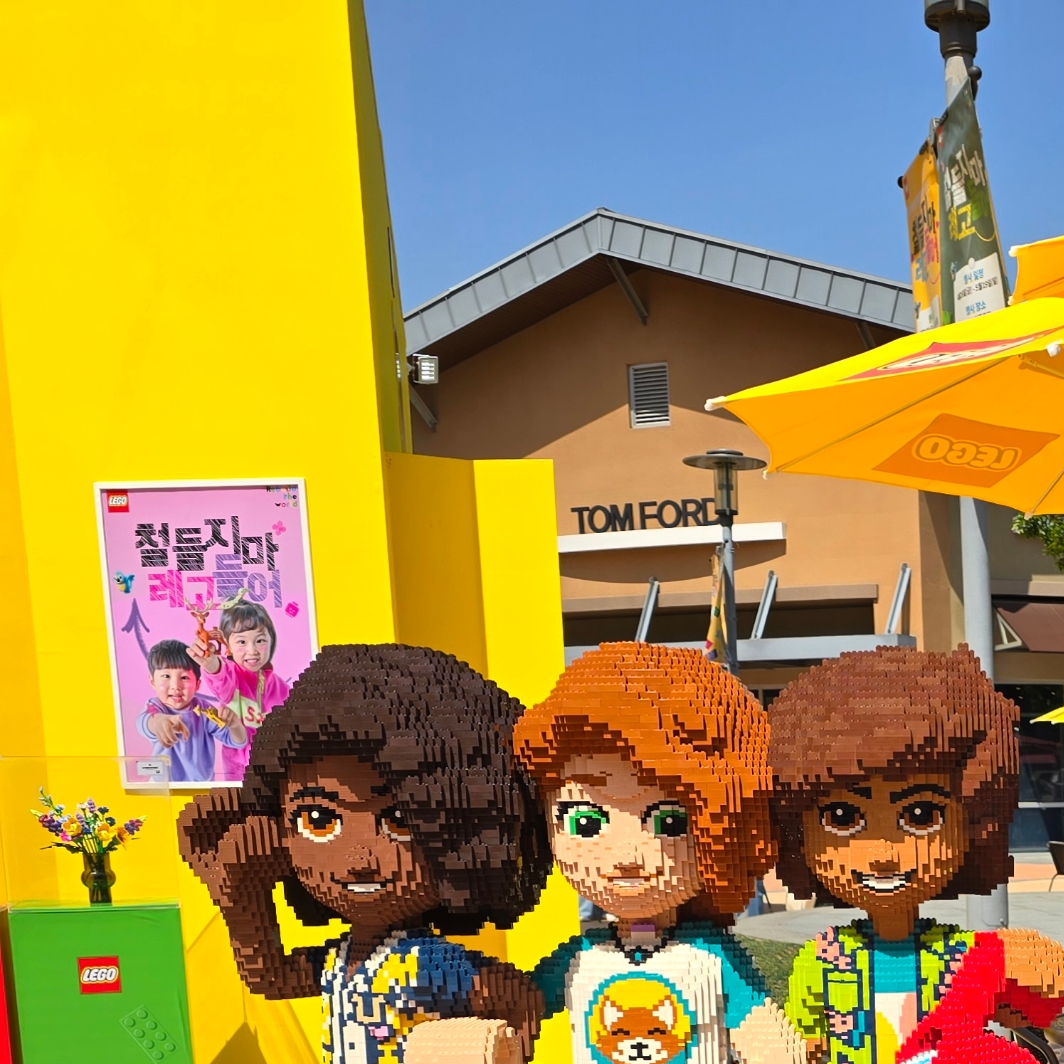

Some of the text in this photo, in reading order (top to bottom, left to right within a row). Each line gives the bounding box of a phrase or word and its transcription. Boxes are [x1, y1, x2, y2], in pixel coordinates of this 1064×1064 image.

[108, 493, 128, 506] LEGO
[571, 497, 720, 534] TOM FORD
[135, 515, 279, 571] 철들지마
[148, 554, 283, 610] 레고들어
[82, 967, 118, 983] LEGO
